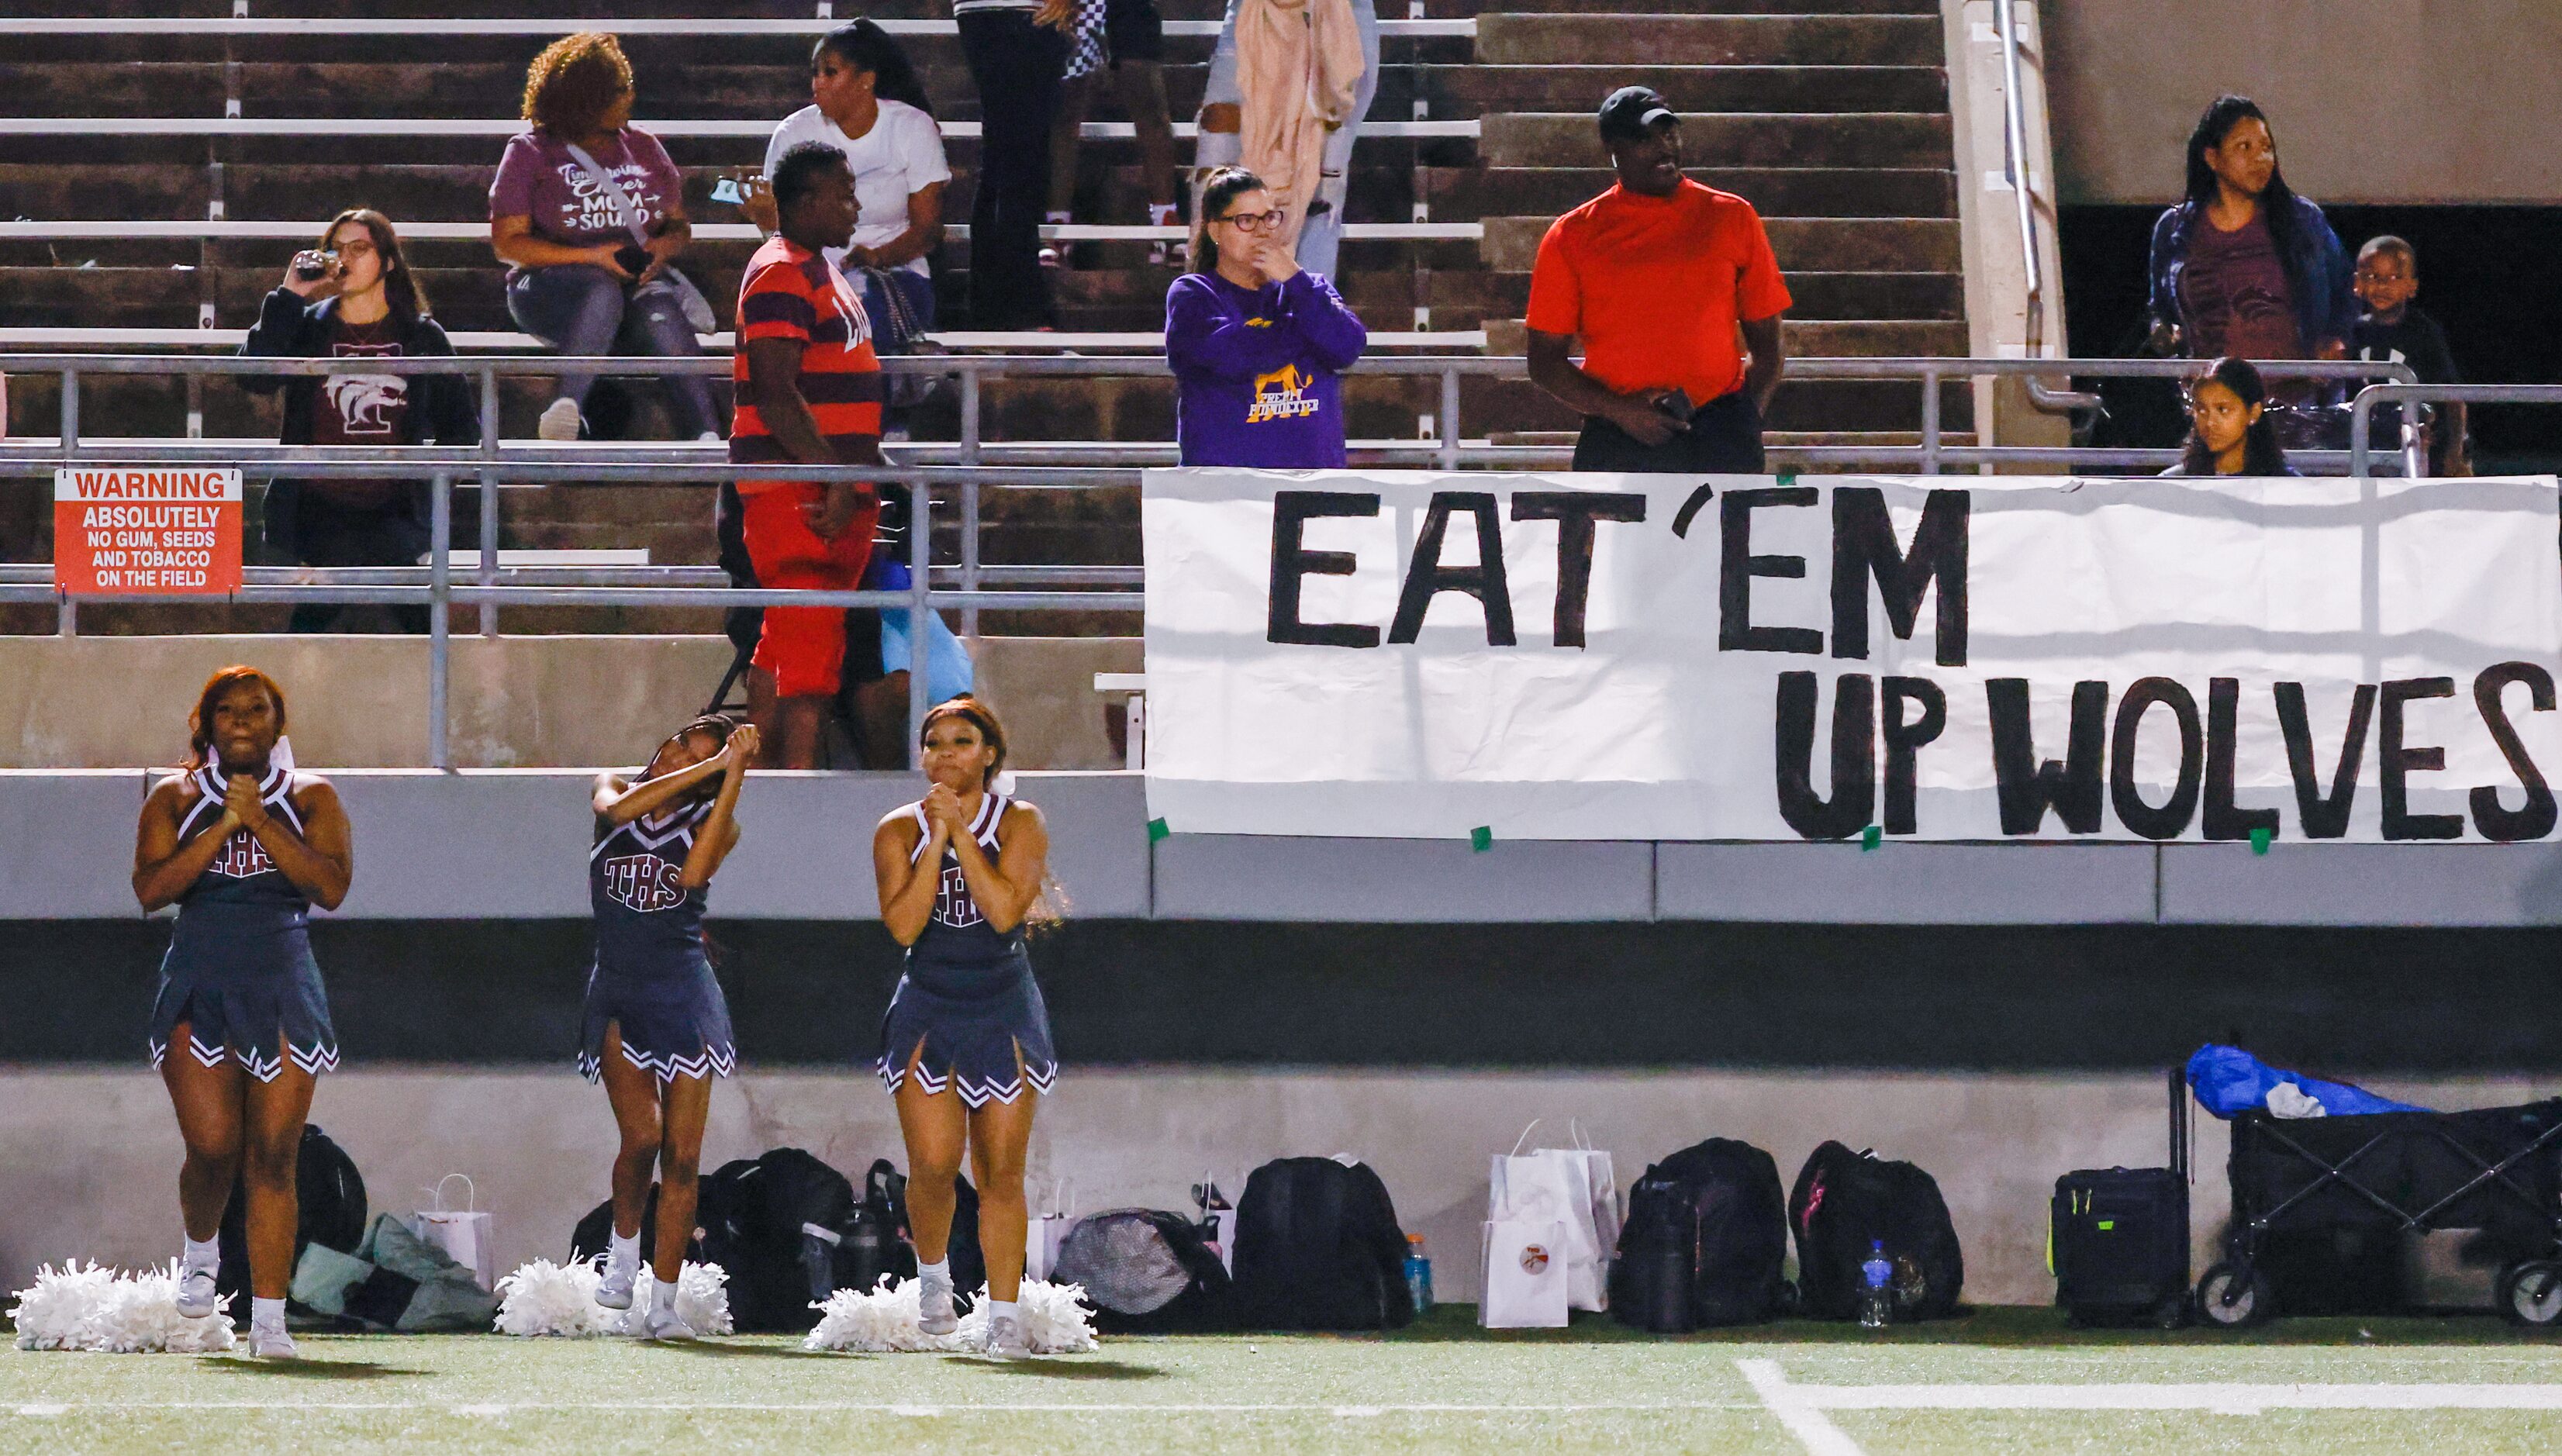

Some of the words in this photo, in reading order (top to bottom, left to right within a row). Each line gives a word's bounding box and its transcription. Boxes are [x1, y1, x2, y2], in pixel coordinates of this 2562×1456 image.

[571, 178, 647, 198] Cer
[579, 209, 650, 230] SQUD
[75, 473, 224, 498] WARNING
[82, 506, 221, 528] ABSOLUTELY
[88, 531, 112, 547] NO
[116, 531, 158, 550] GUM,
[162, 531, 216, 547] SEEDS
[92, 550, 127, 567] AND
[131, 550, 210, 567] TOBACCO
[96, 570, 120, 587] ON
[125, 570, 157, 586] THE
[161, 570, 206, 586] FIELD
[1266, 491, 1647, 651] EAT
[1671, 482, 1971, 668] 'EM
[1775, 671, 1947, 840] UP
[1985, 661, 2558, 842] WOLVES
[605, 853, 687, 913] THS
